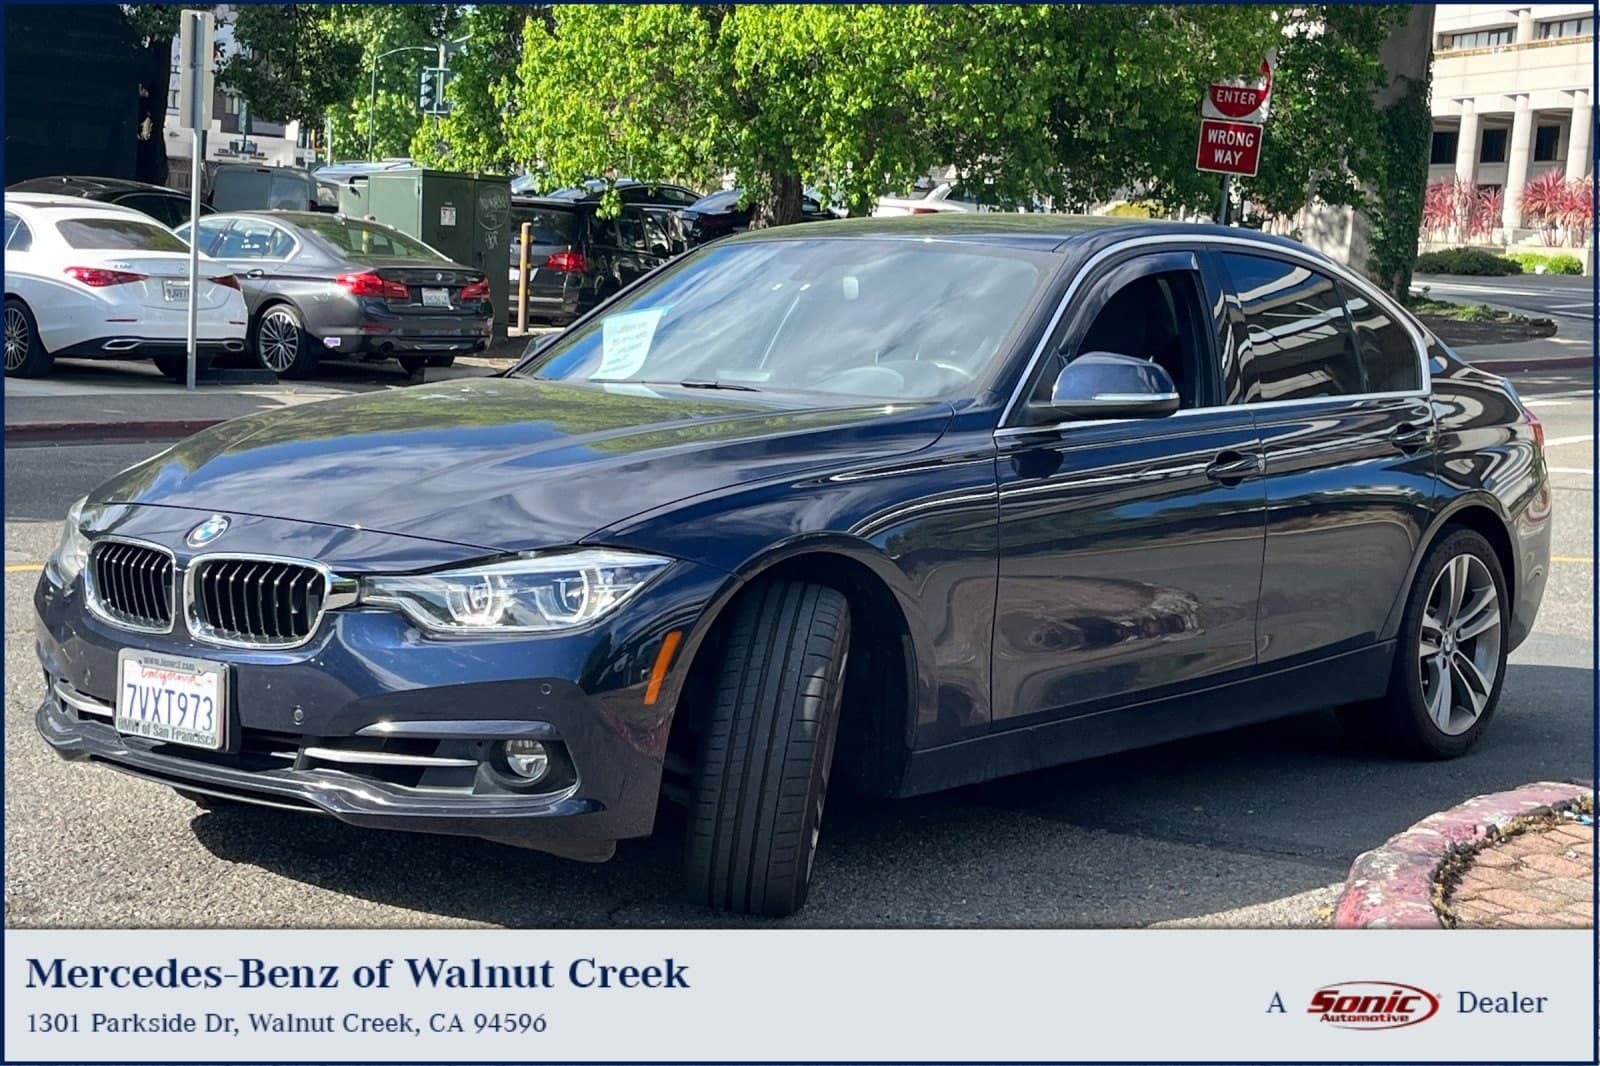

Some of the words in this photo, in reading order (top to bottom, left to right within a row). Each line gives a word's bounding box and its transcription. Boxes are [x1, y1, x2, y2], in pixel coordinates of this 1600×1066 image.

[1216, 89, 1257, 105] ENTER
[1207, 128, 1254, 148] WRONG
[1214, 148, 1243, 165] WAY
[127, 683, 214, 731] 7VXT973
[118, 716, 140, 734] BMW
[142, 722, 150, 734] of
[152, 723, 169, 740] San
[171, 727, 217, 746] Francisco
